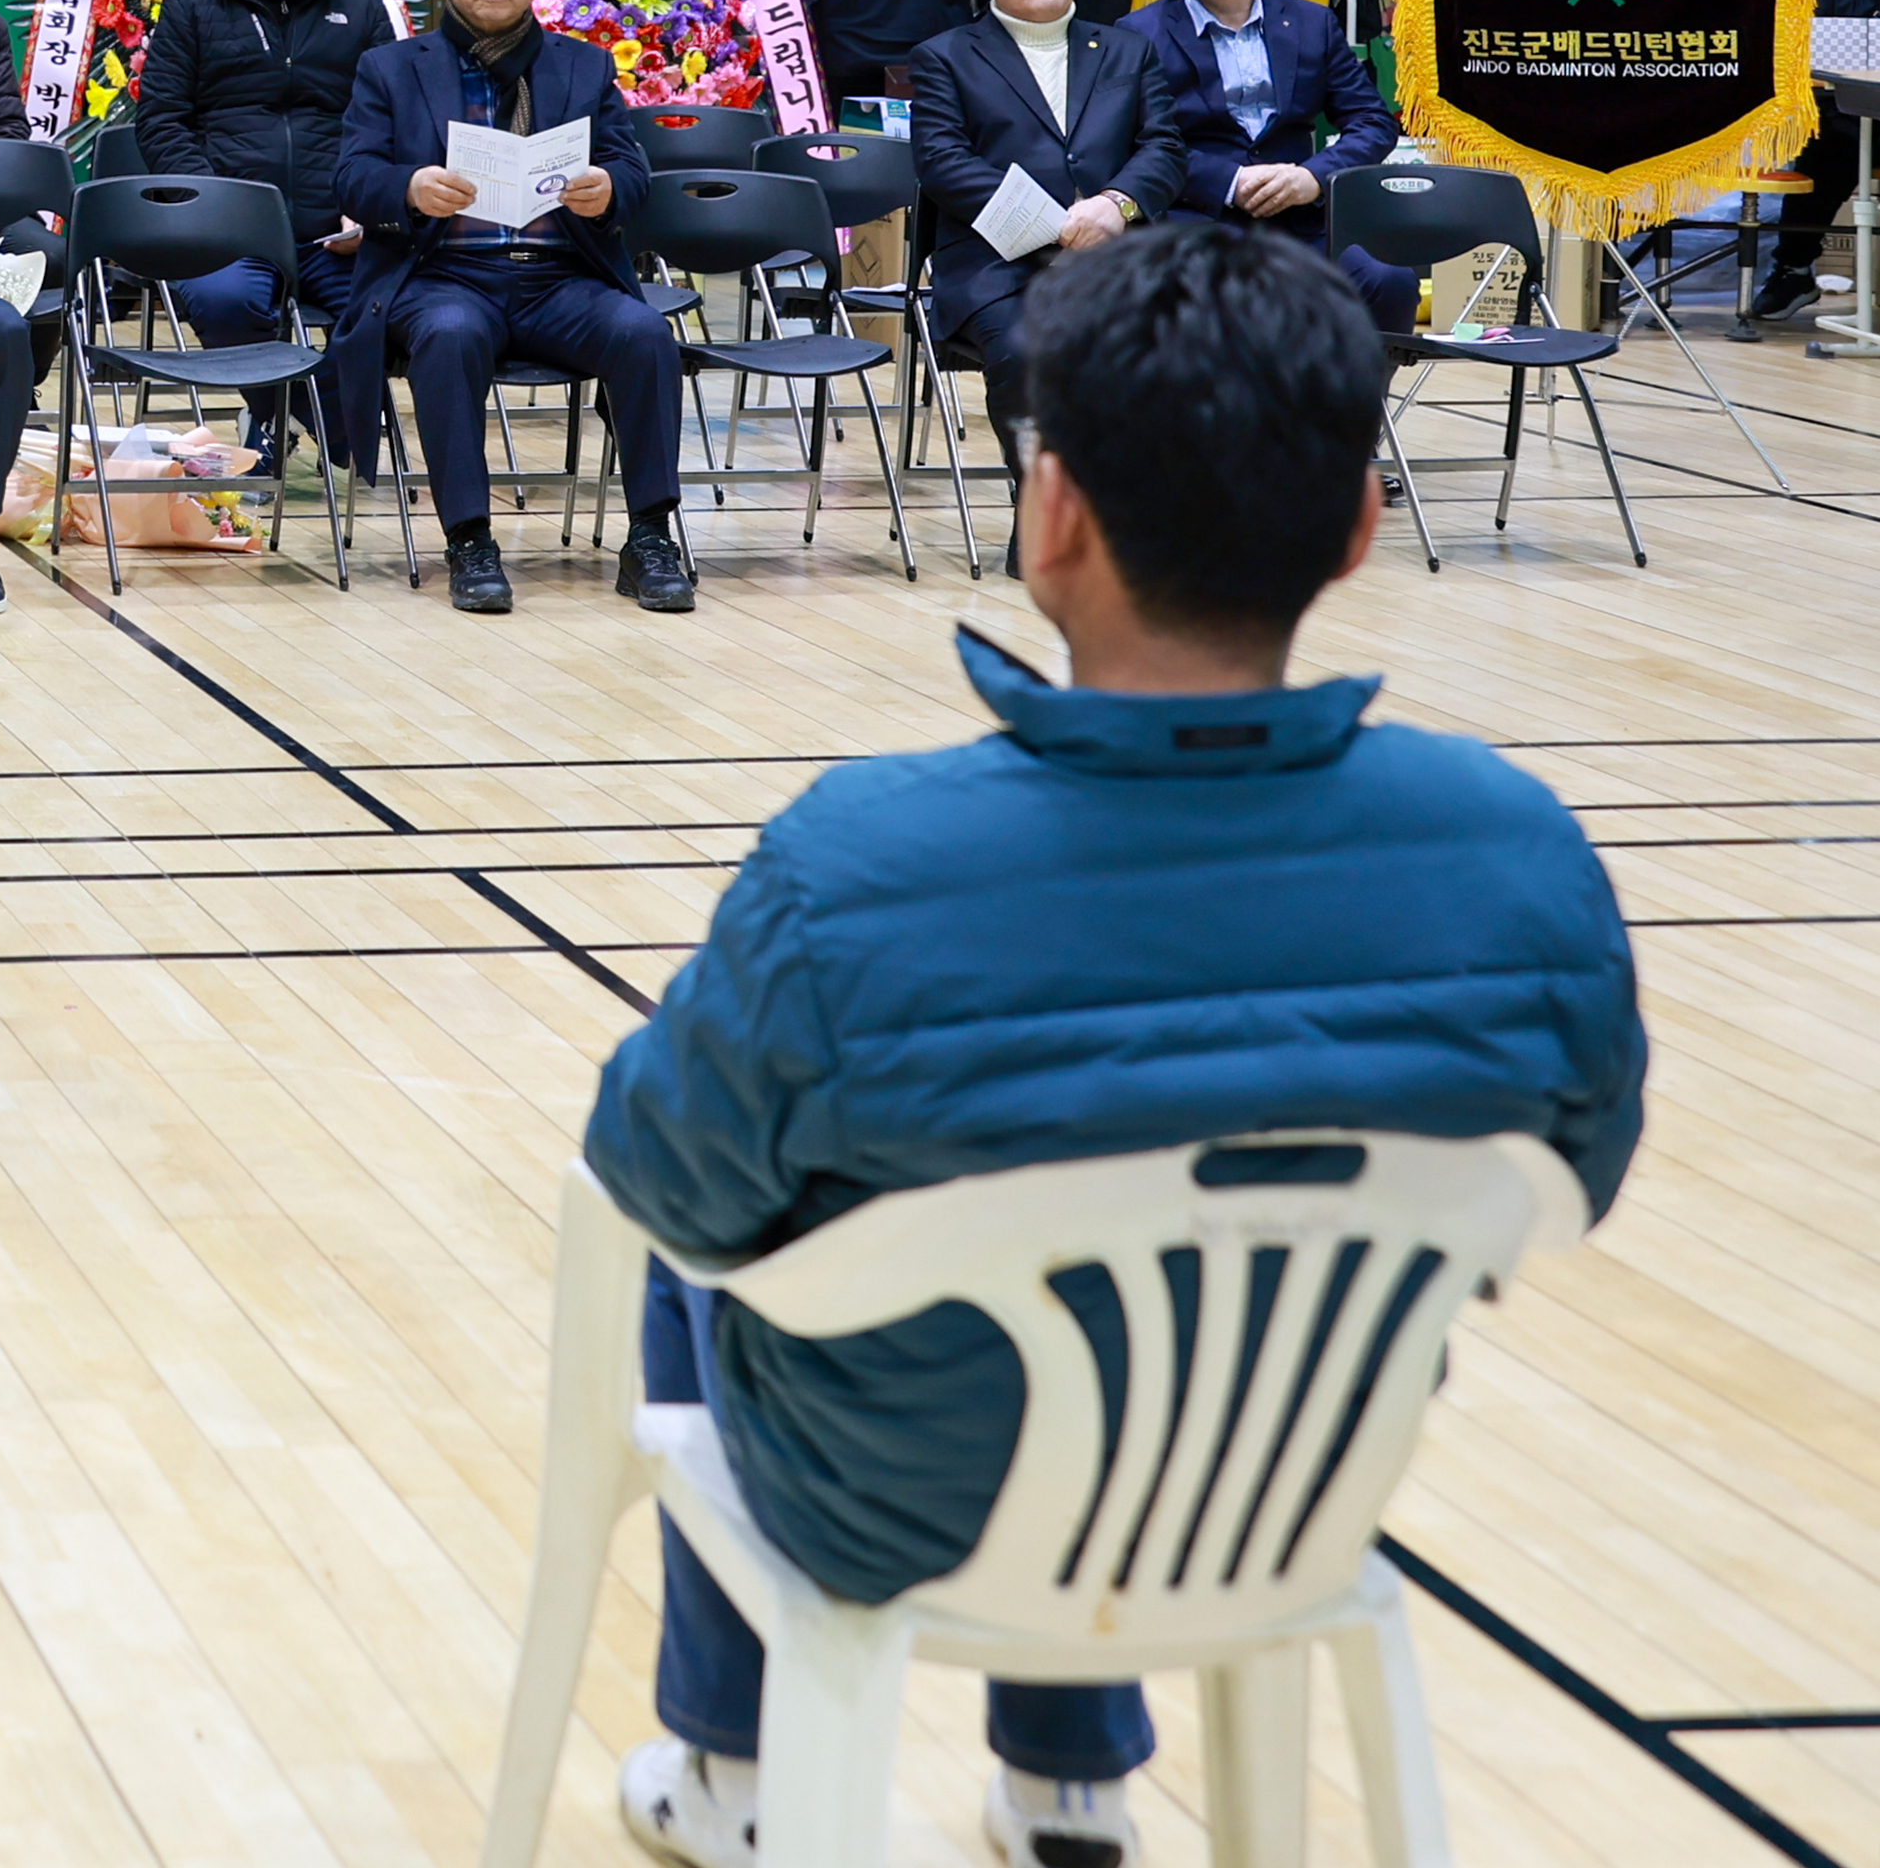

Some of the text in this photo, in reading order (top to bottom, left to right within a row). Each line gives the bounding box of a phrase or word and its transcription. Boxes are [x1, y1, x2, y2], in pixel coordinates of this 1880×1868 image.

[1462, 28, 1739, 61] 진도군배드민턴협회
[1462, 59, 1740, 78] JINDO BADMINTON ASSOCIATION
